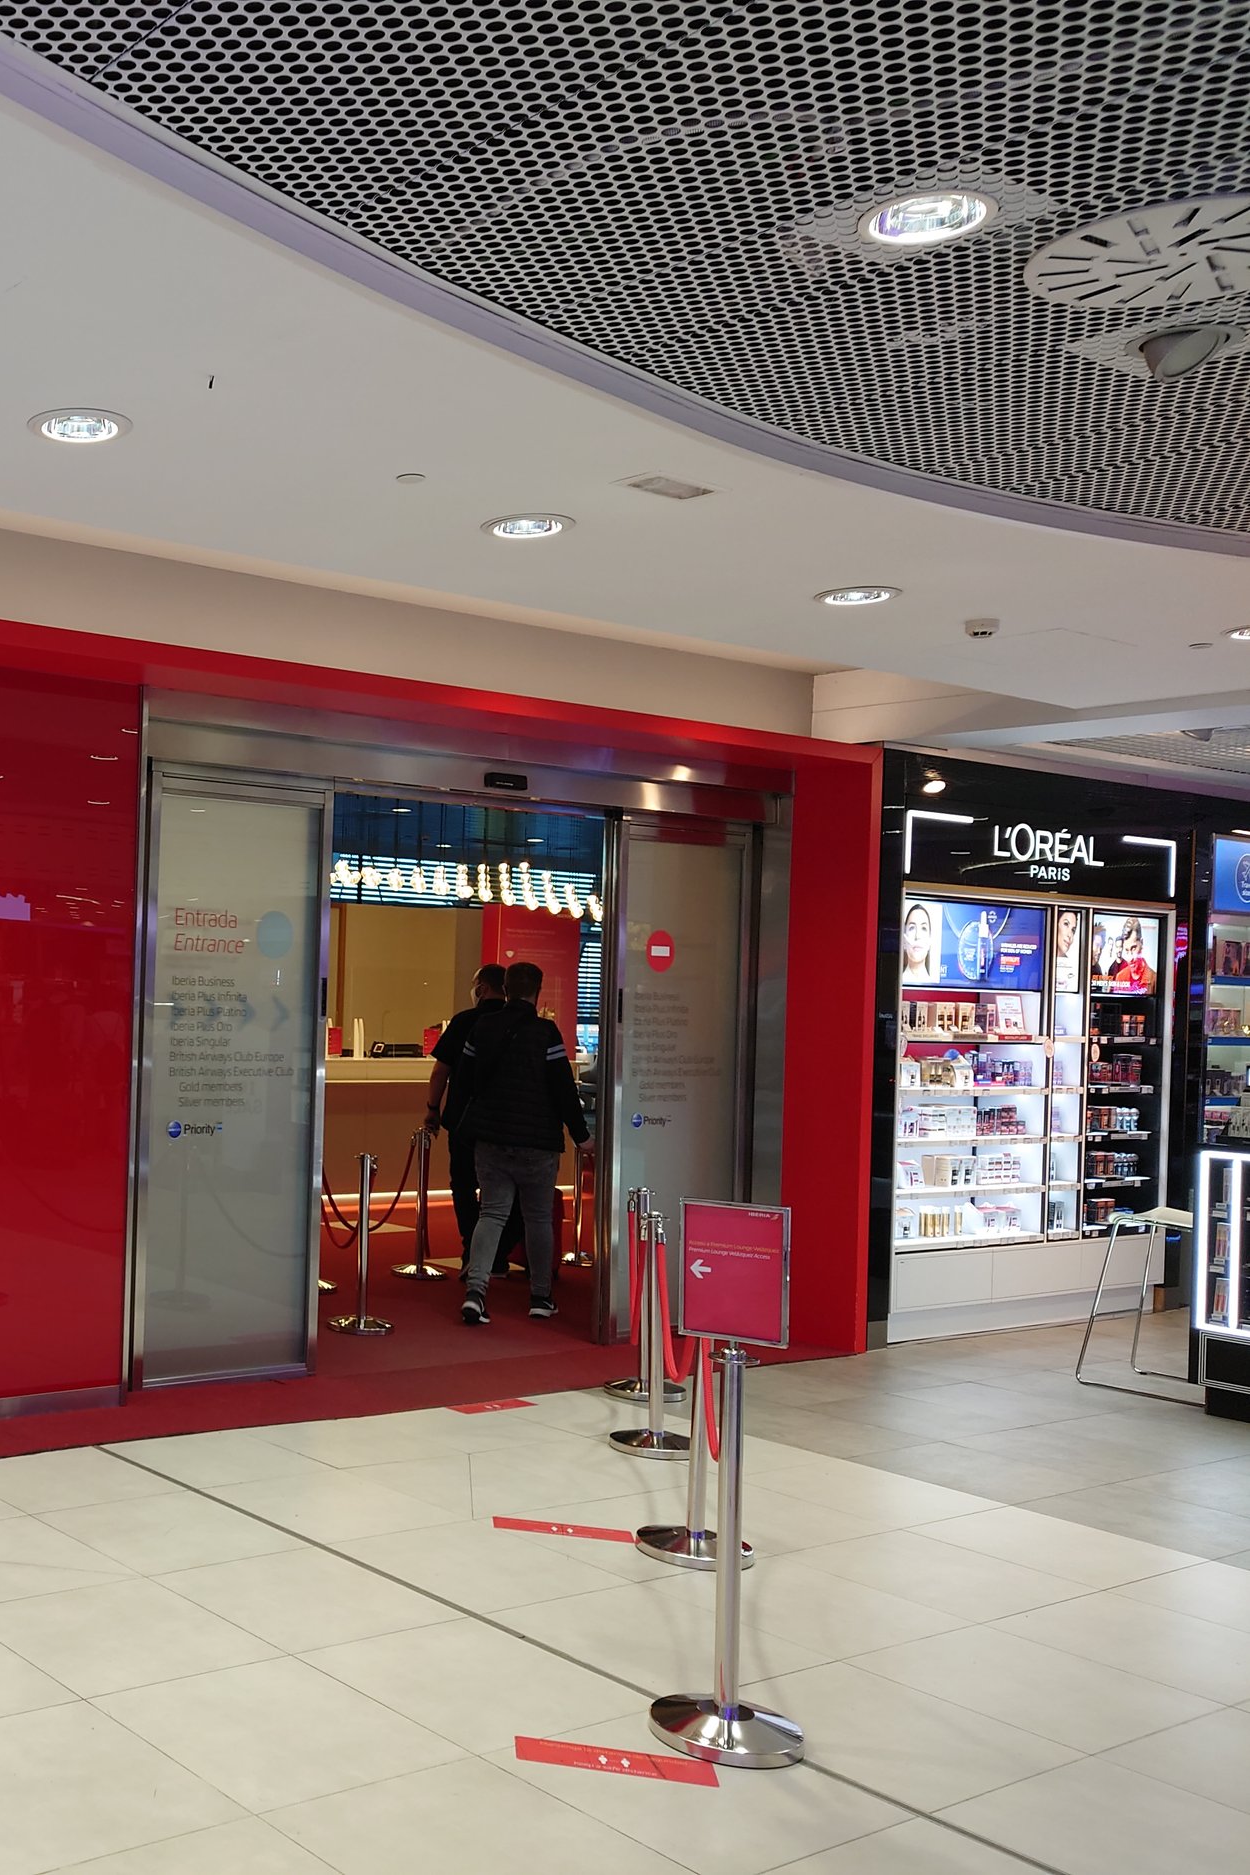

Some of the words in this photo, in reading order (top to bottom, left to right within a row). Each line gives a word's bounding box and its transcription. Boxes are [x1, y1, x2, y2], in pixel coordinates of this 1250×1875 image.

[993, 823, 1104, 867] L'ORÉAL
[175, 907, 238, 929] Entrada
[174, 933, 245, 954] Entrance
[172, 976, 196, 986] Iberia
[198, 976, 235, 987] Business
[171, 1036, 194, 1047] Iberia
[197, 1037, 230, 1049] Singular
[169, 1051, 196, 1061] British
[199, 1052, 232, 1064] Airways
[169, 1066, 196, 1077] British
[199, 1067, 232, 1079] Airways
[179, 1082, 199, 1092] Gold
[183, 1123, 216, 1136] Priority
